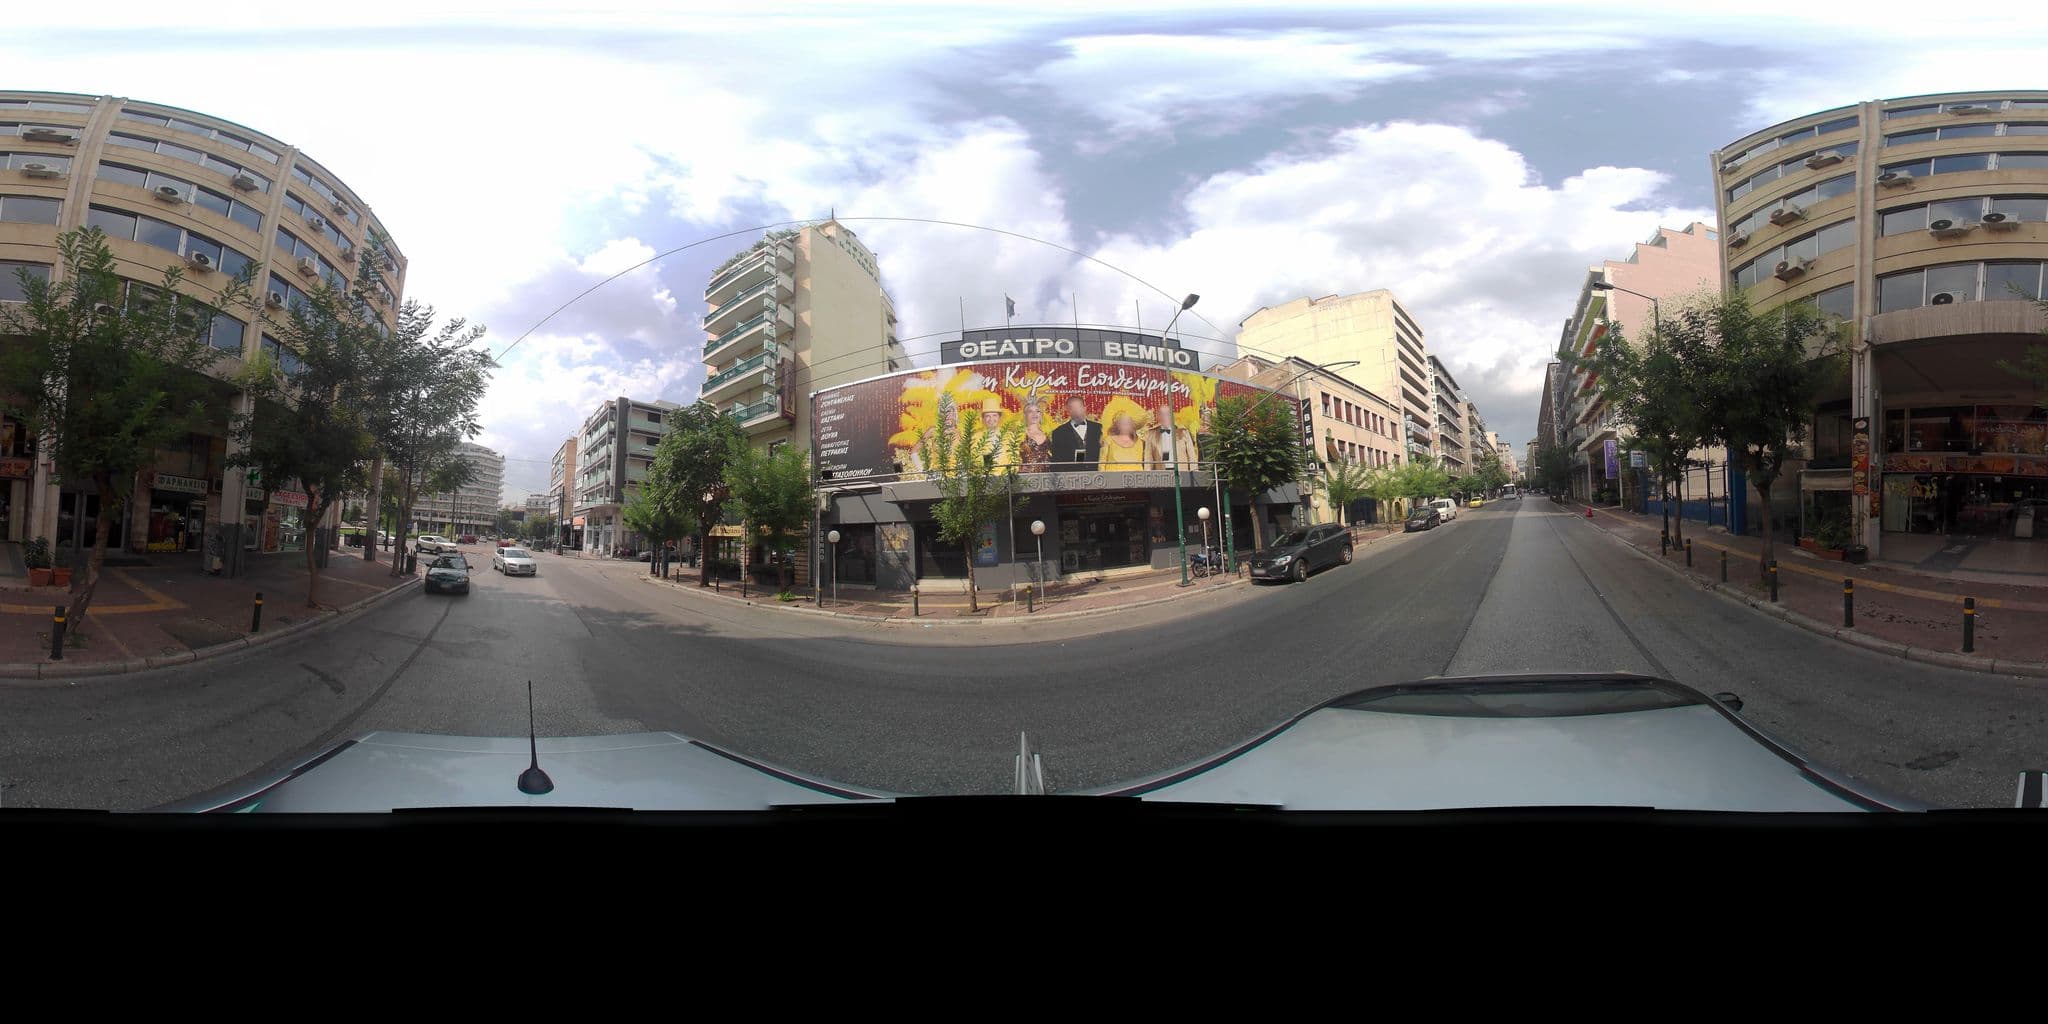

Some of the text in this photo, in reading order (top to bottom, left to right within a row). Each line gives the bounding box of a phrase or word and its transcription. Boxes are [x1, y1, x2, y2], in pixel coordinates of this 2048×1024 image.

[960, 338, 1191, 365] ΘΕΑΤΡΟ ΒΕΜΠΟ
[1005, 364, 1068, 398] Κυρία
[1078, 365, 1191, 398] Επιθεώρηση
